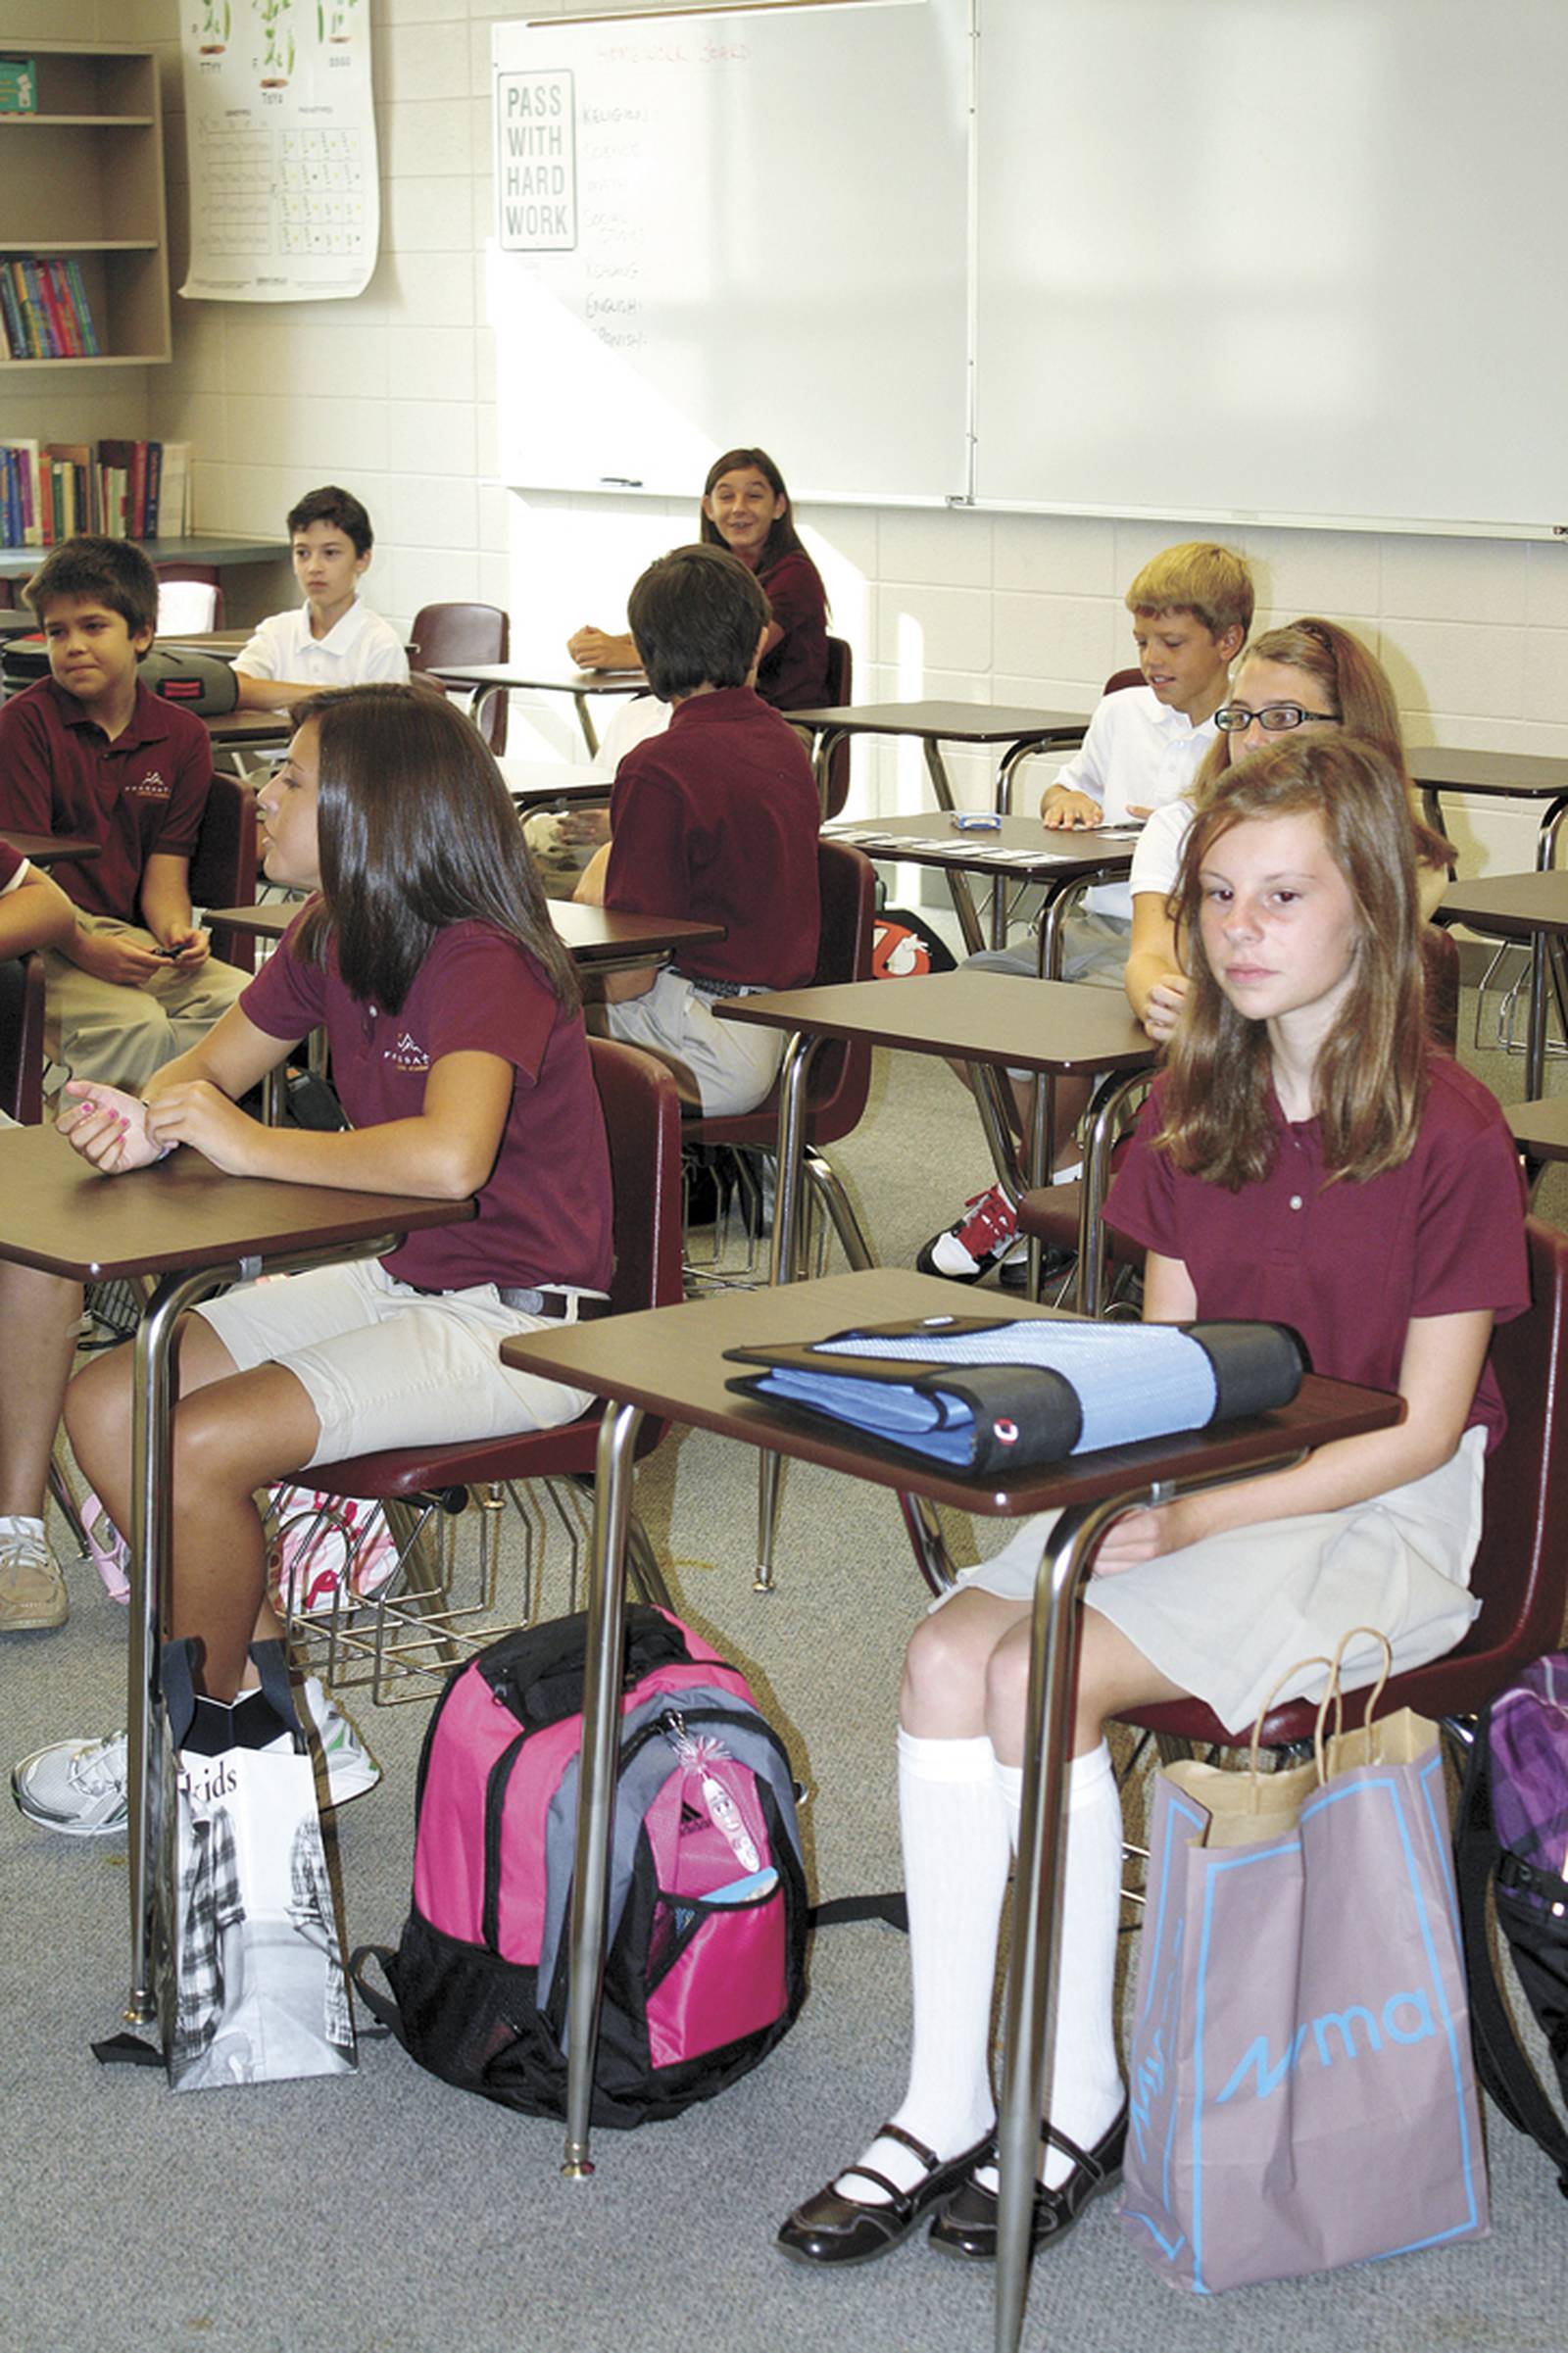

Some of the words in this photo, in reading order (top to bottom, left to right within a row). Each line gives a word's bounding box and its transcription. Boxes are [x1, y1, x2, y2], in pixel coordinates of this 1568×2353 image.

[506, 84, 562, 118] PASS
[507, 125, 563, 157] WITH
[507, 165, 565, 196] HARD
[505, 205, 568, 235] WORK
